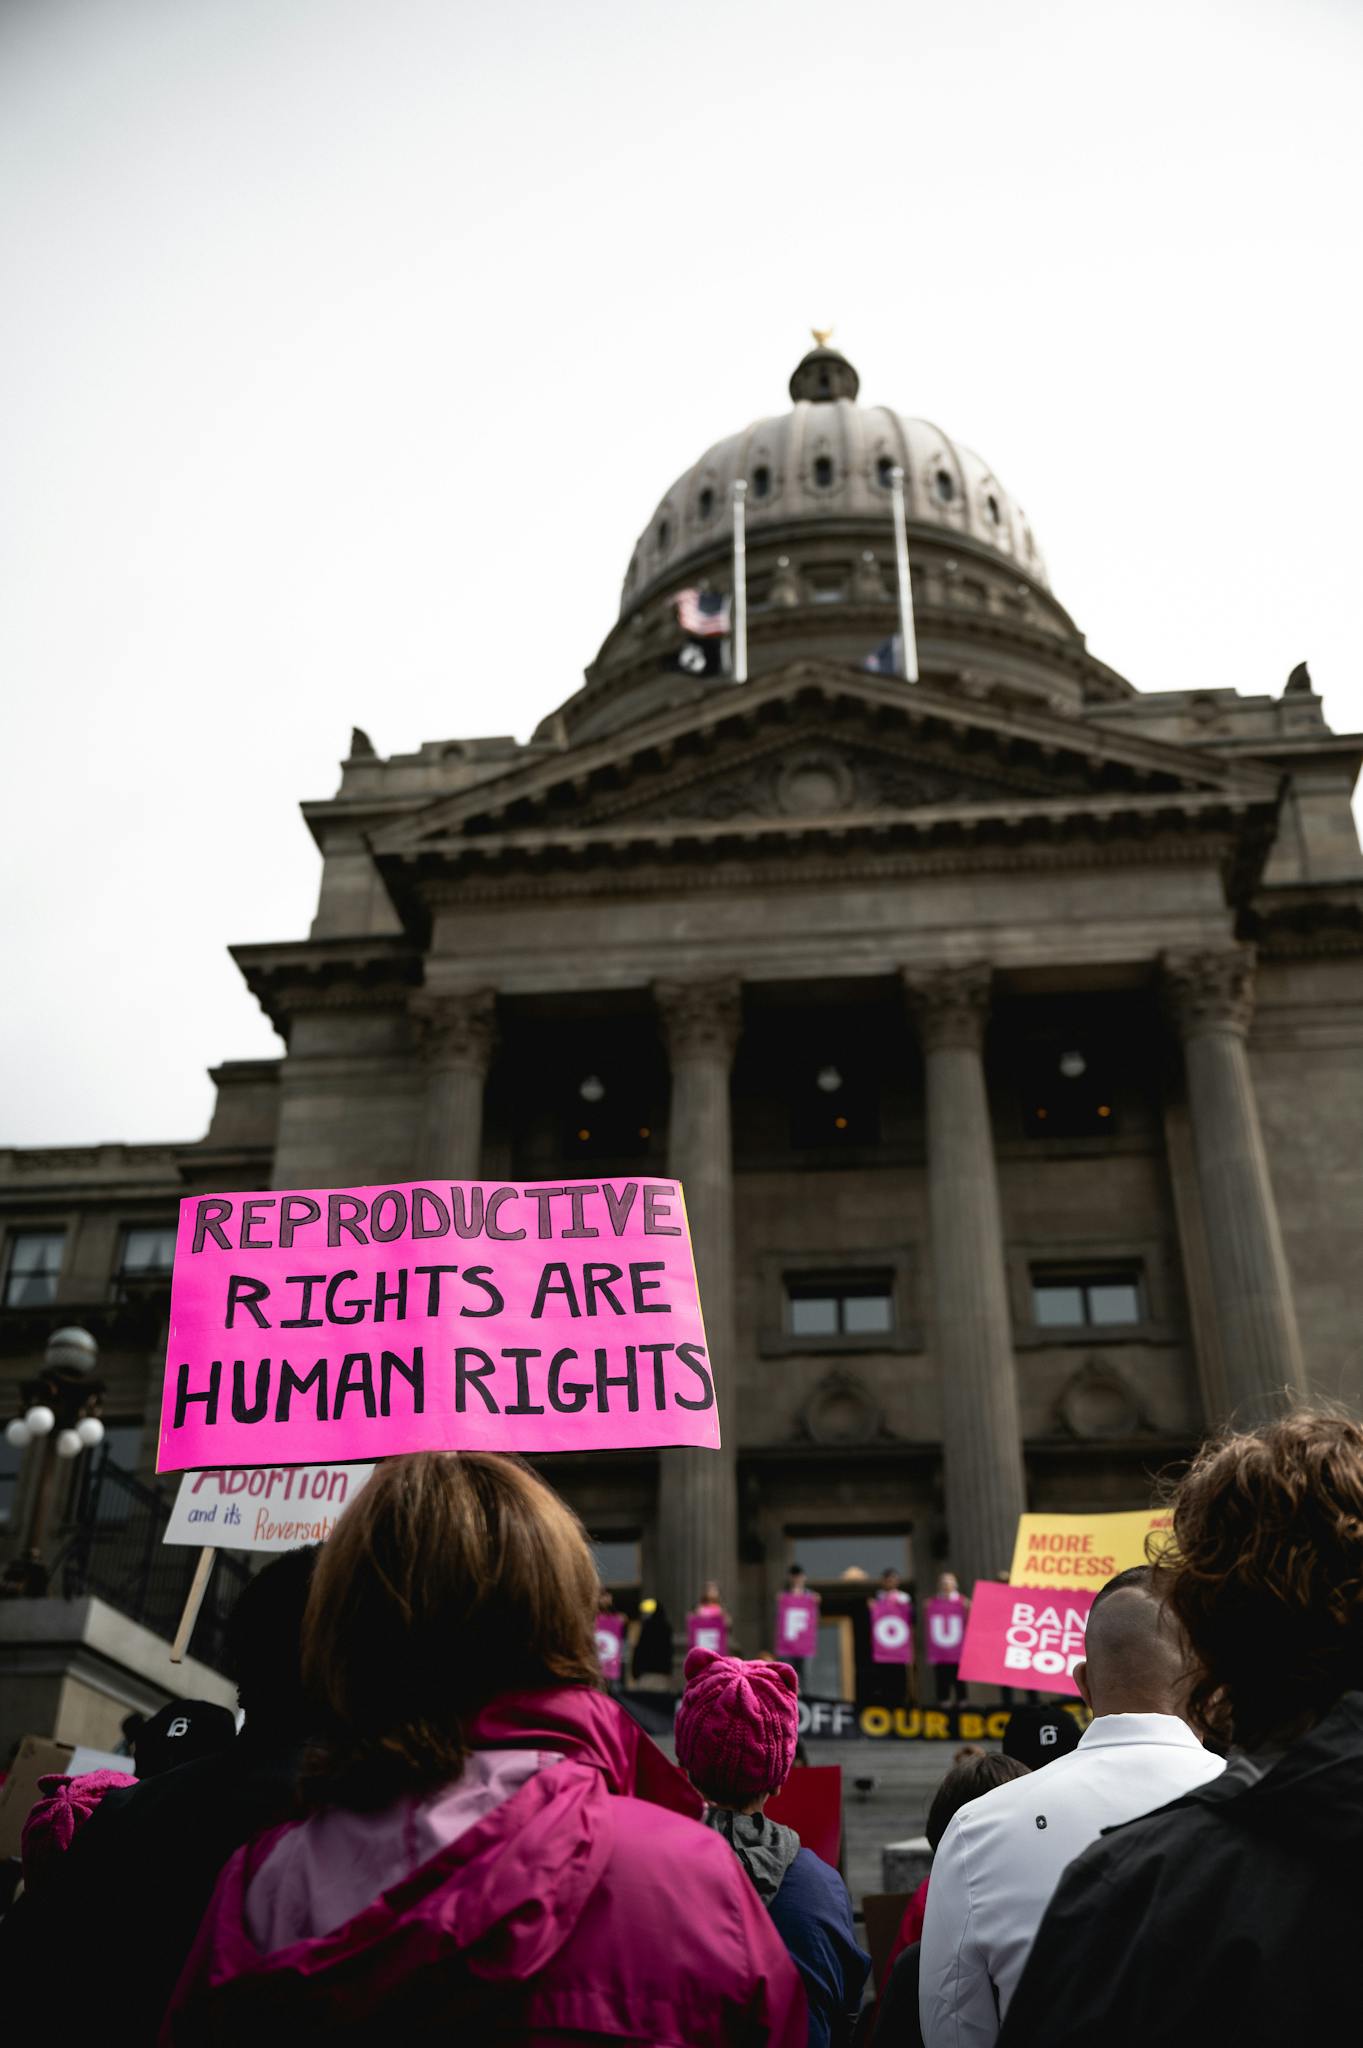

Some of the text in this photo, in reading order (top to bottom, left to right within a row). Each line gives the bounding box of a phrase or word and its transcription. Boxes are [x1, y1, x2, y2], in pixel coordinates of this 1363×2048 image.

[191, 1182, 682, 1254] REPRODUCTIVE
[224, 1261, 672, 1329] RIGHTS ARE
[173, 1342, 714, 1429] HUMAN RIGHTS
[187, 1503, 218, 1524] and
[1027, 1533, 1095, 1553] MORE
[783, 1607, 810, 1642] F
[873, 1615, 911, 1649] O
[930, 1613, 964, 1649] U
[1005, 1624, 1084, 1654] OFF
[859, 1705, 950, 1738] OUR
